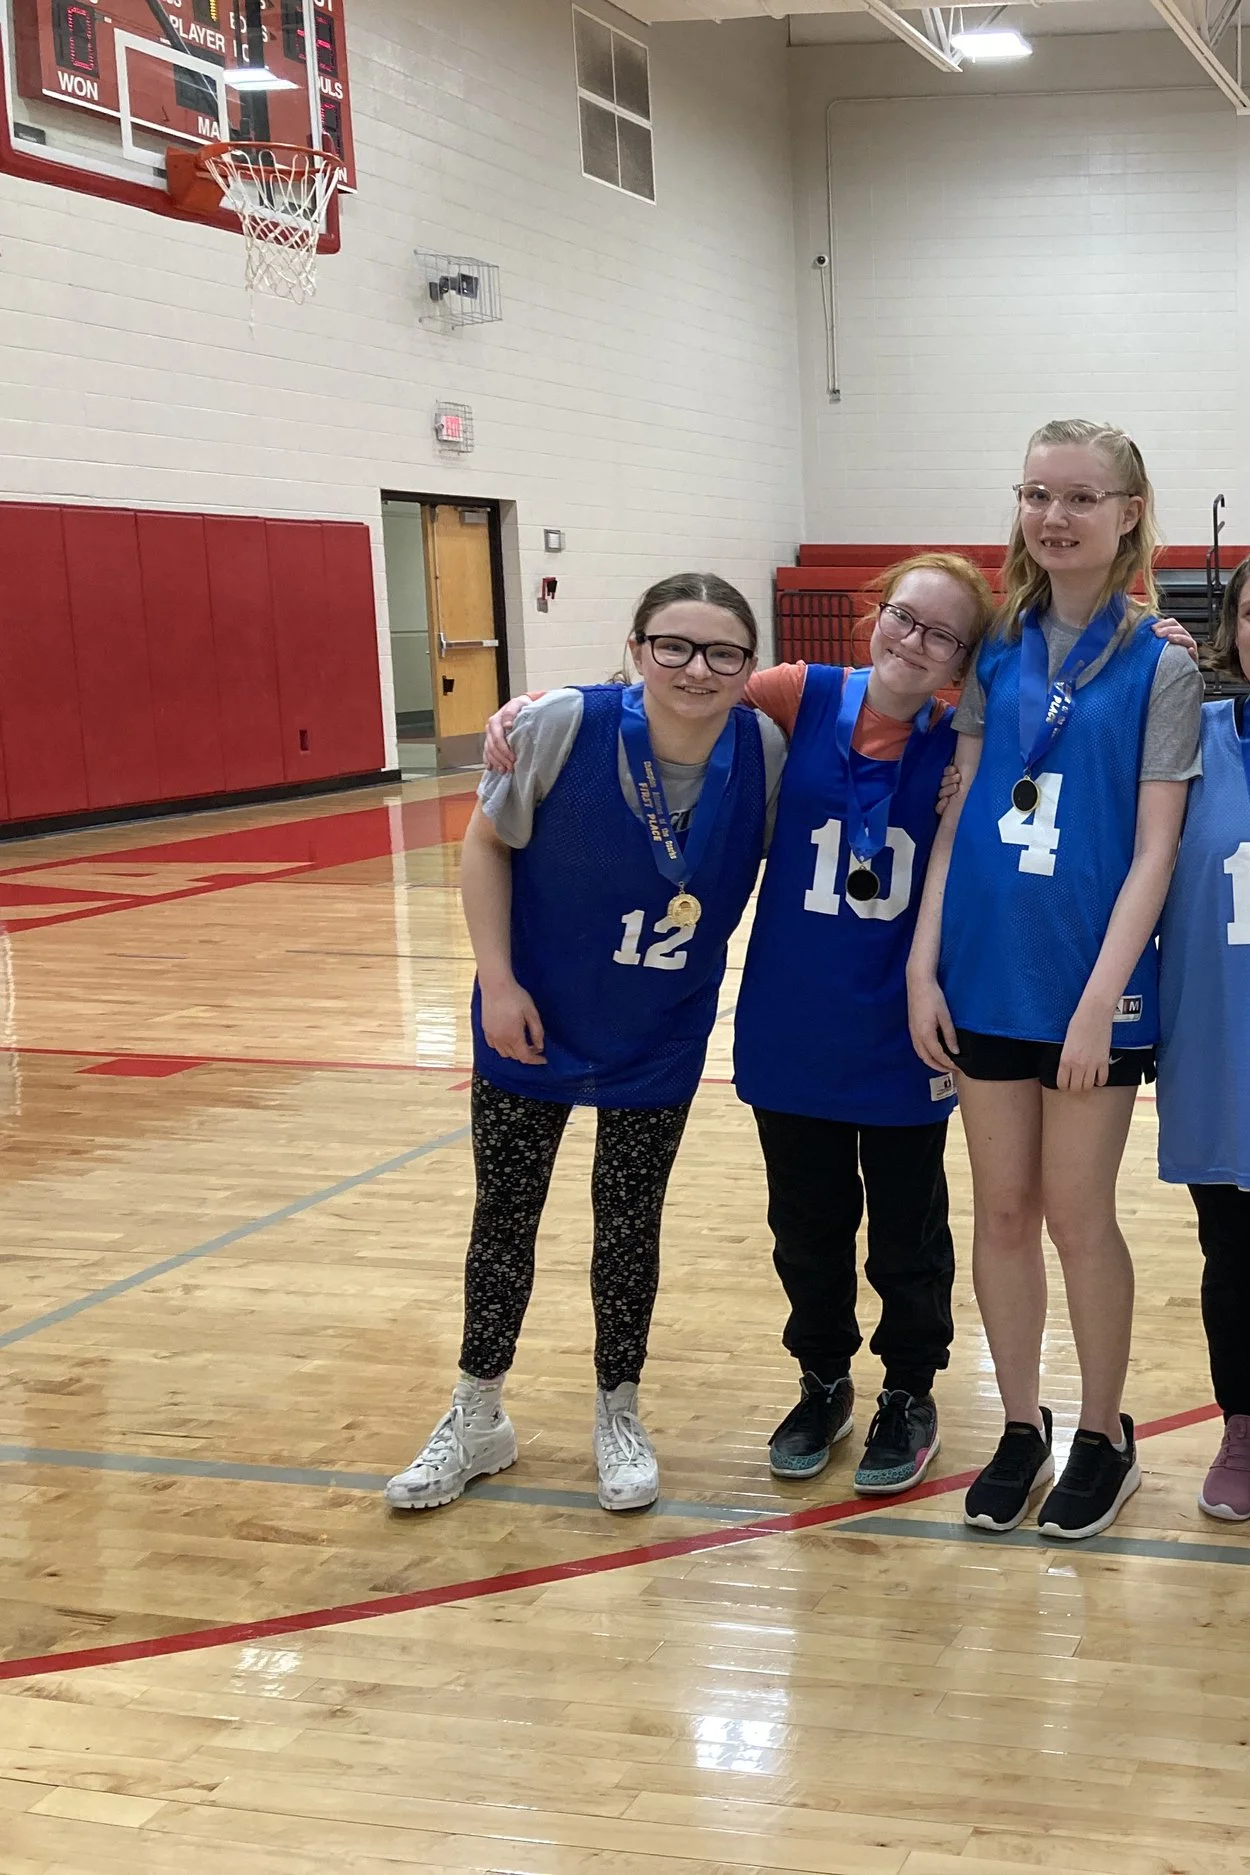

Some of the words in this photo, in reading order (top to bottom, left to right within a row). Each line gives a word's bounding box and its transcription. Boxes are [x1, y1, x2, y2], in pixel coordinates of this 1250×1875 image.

[169, 14, 226, 53] PLAYER
[57, 70, 99, 101] WON
[638, 782, 653, 808] FIRST
[647, 813, 662, 841] PLACE
[997, 772, 1063, 876] 4
[804, 818, 916, 921] 10
[612, 909, 697, 970] 12
